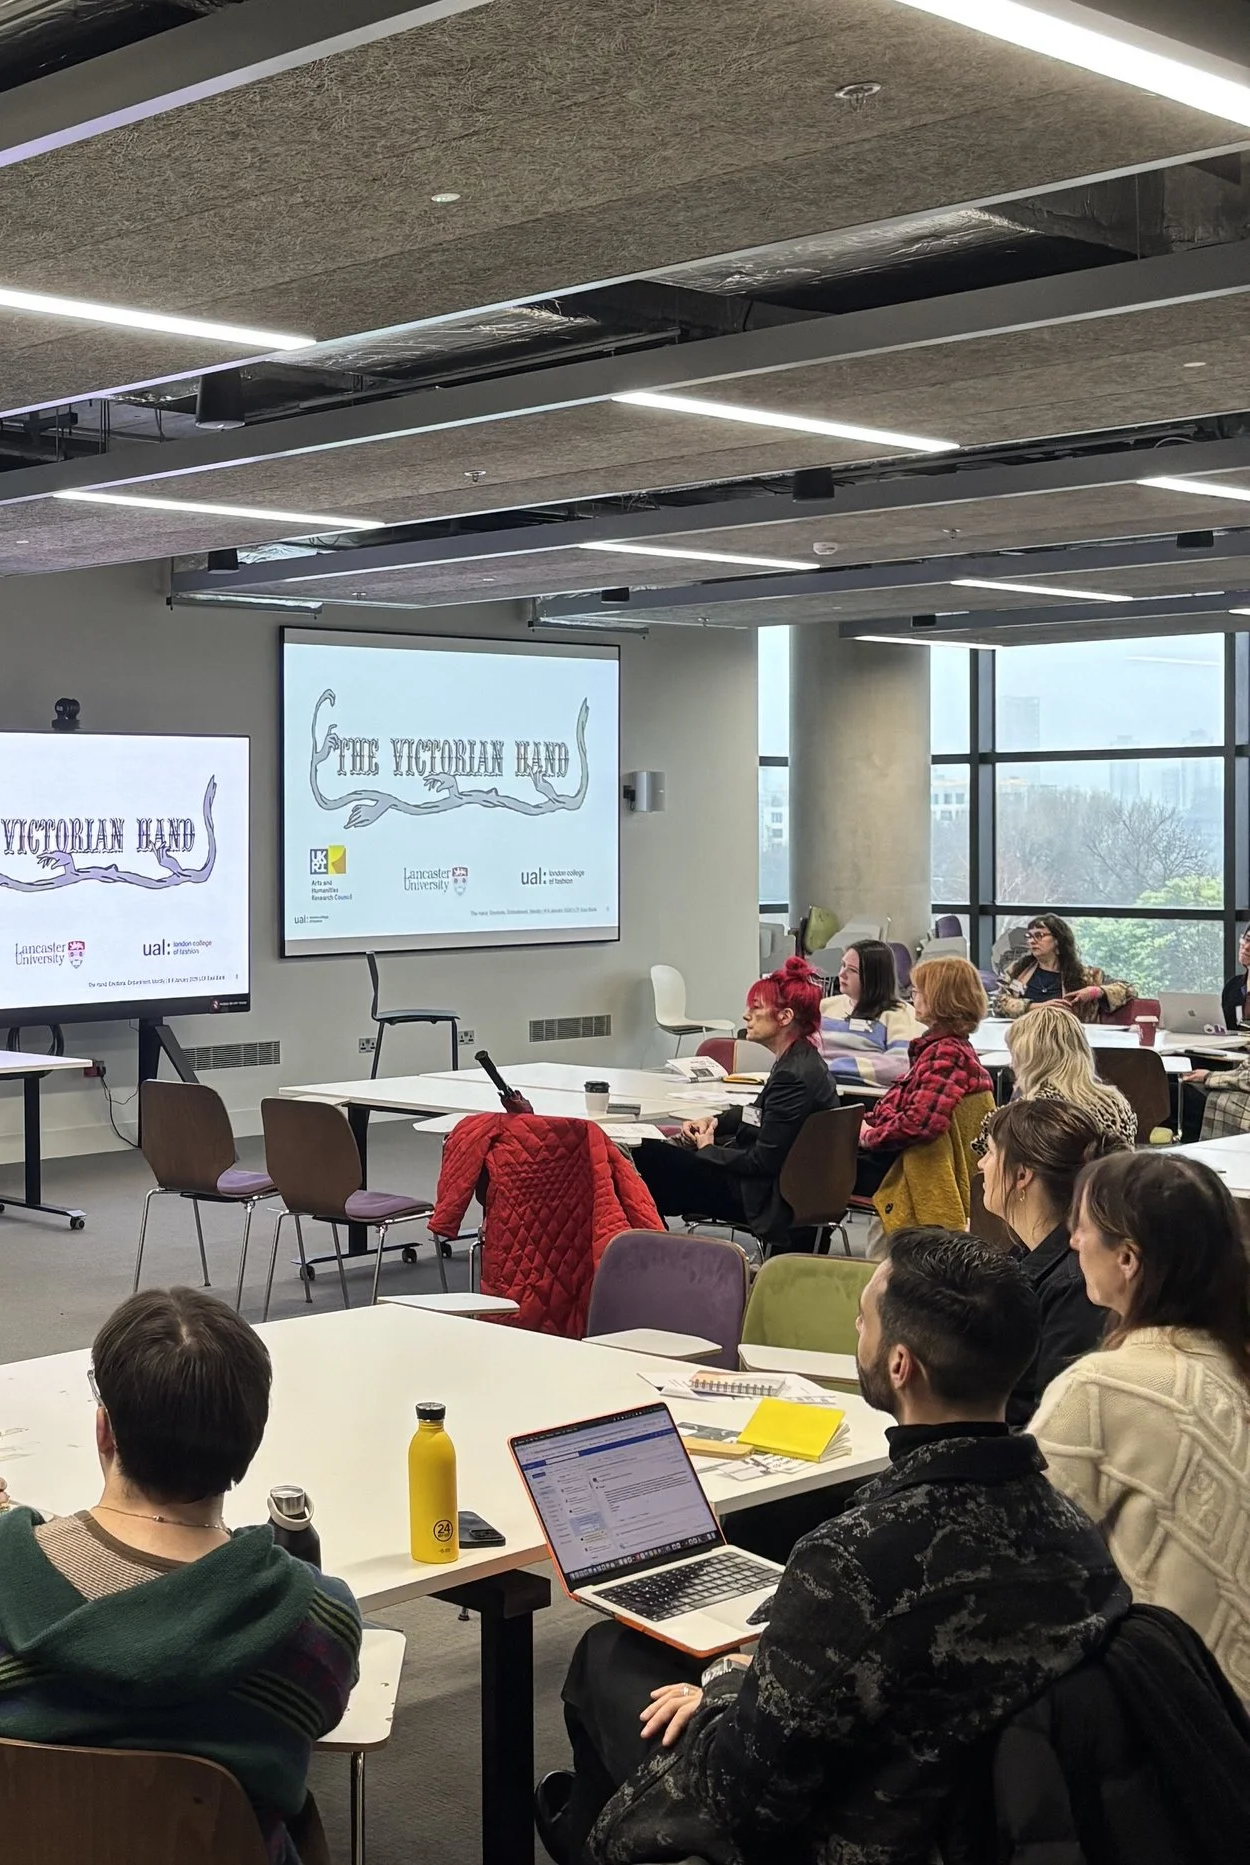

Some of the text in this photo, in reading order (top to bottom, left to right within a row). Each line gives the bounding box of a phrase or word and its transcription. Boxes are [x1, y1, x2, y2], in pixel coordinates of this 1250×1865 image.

[336, 737, 570, 778] THE VICTORIAN HAND
[0, 817, 126, 855] VICTORIAN
[136, 817, 196, 853] HAND
[311, 851, 327, 862] UK
[311, 862, 327, 873] RI
[403, 867, 451, 880] Lancaster
[521, 867, 547, 885] ual:
[403, 878, 449, 892] University
[15, 942, 66, 956] Lancaster
[143, 939, 170, 956] ual:
[15, 953, 65, 967] University
[437, 1523, 451, 1534] 24
